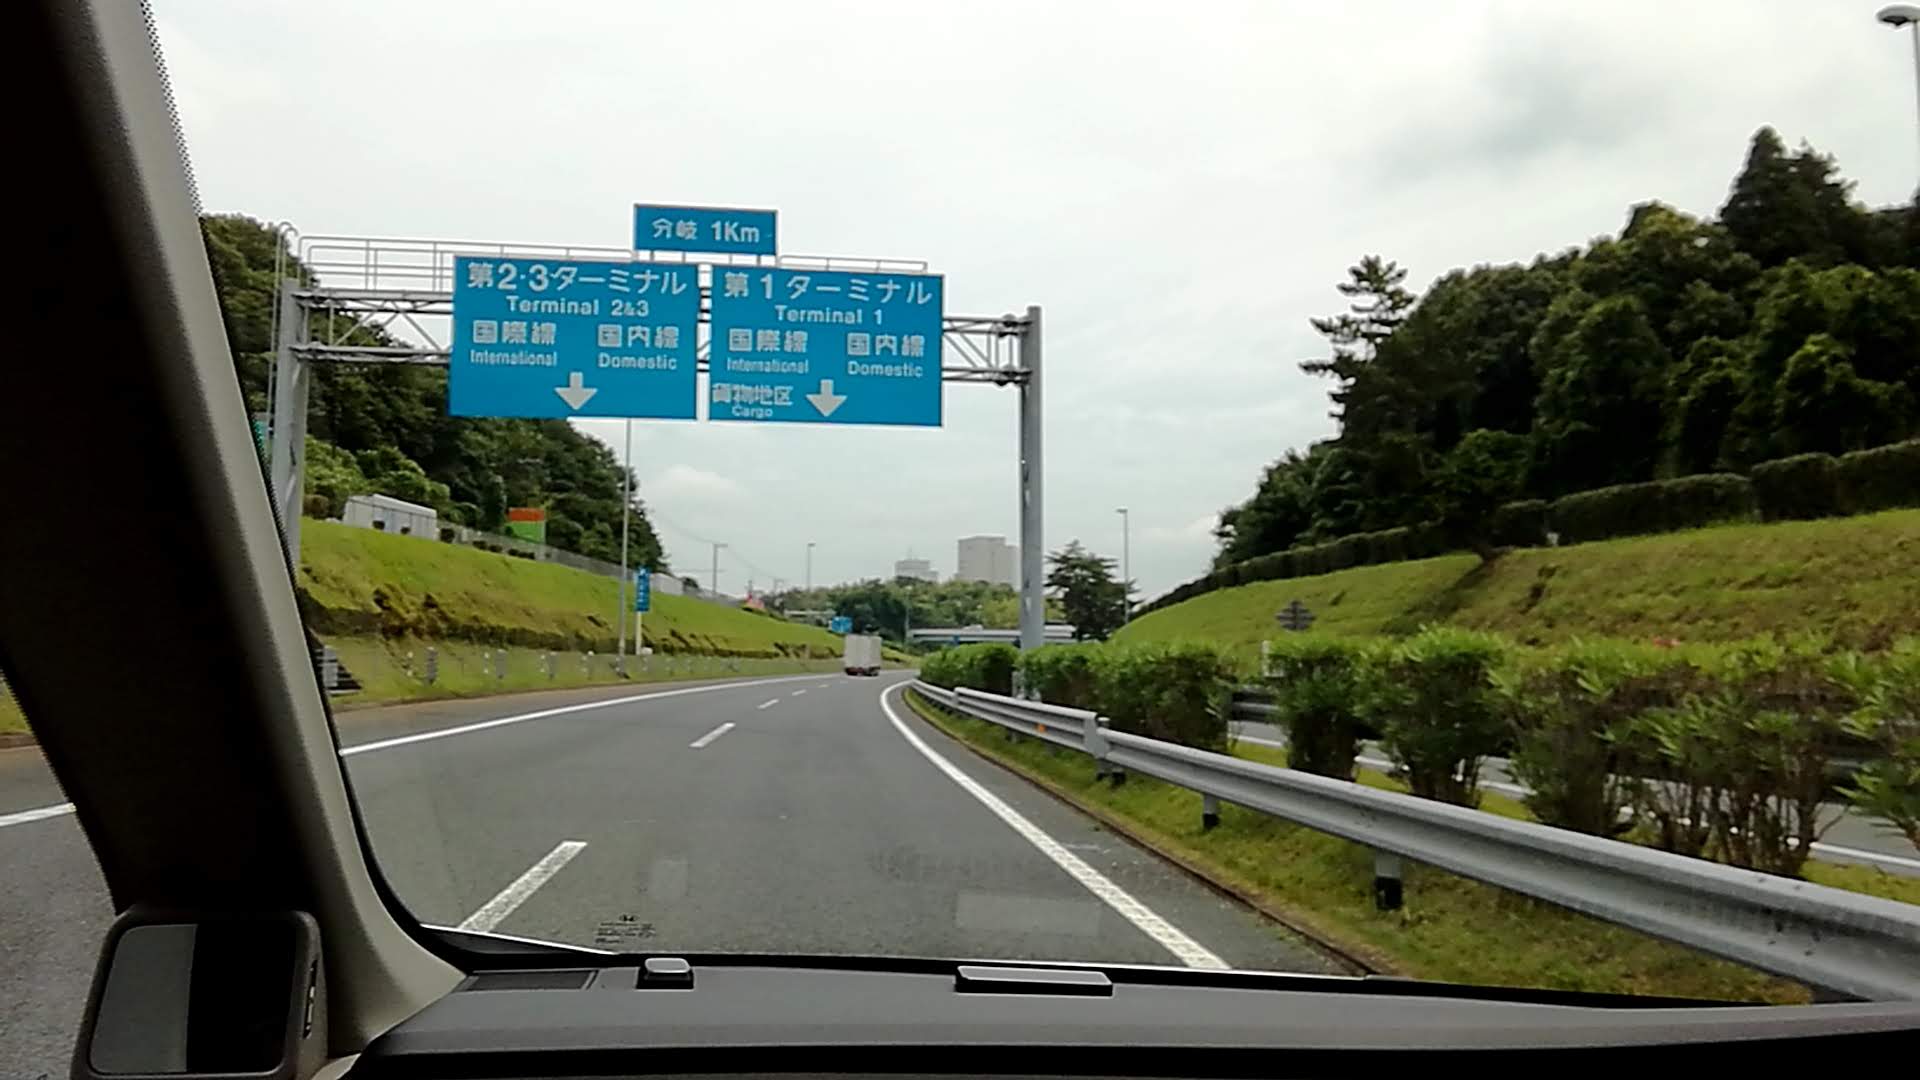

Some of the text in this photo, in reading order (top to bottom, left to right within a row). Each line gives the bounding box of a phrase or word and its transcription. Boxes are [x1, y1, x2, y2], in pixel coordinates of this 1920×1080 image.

[652, 218, 760, 243] 分岐 1Km
[506, 295, 649, 317] Terminal 2&3
[774, 305, 883, 325] Terminal 1
[472, 320, 556, 346] 国際線
[598, 324, 680, 349] 国内線
[729, 328, 808, 353] 国際線
[847, 333, 925, 357] 国内線
[470, 349, 557, 367] International
[598, 352, 678, 371] Domestic
[727, 357, 809, 374] International
[847, 361, 924, 378] Domestic
[732, 405, 774, 420] Cargo
